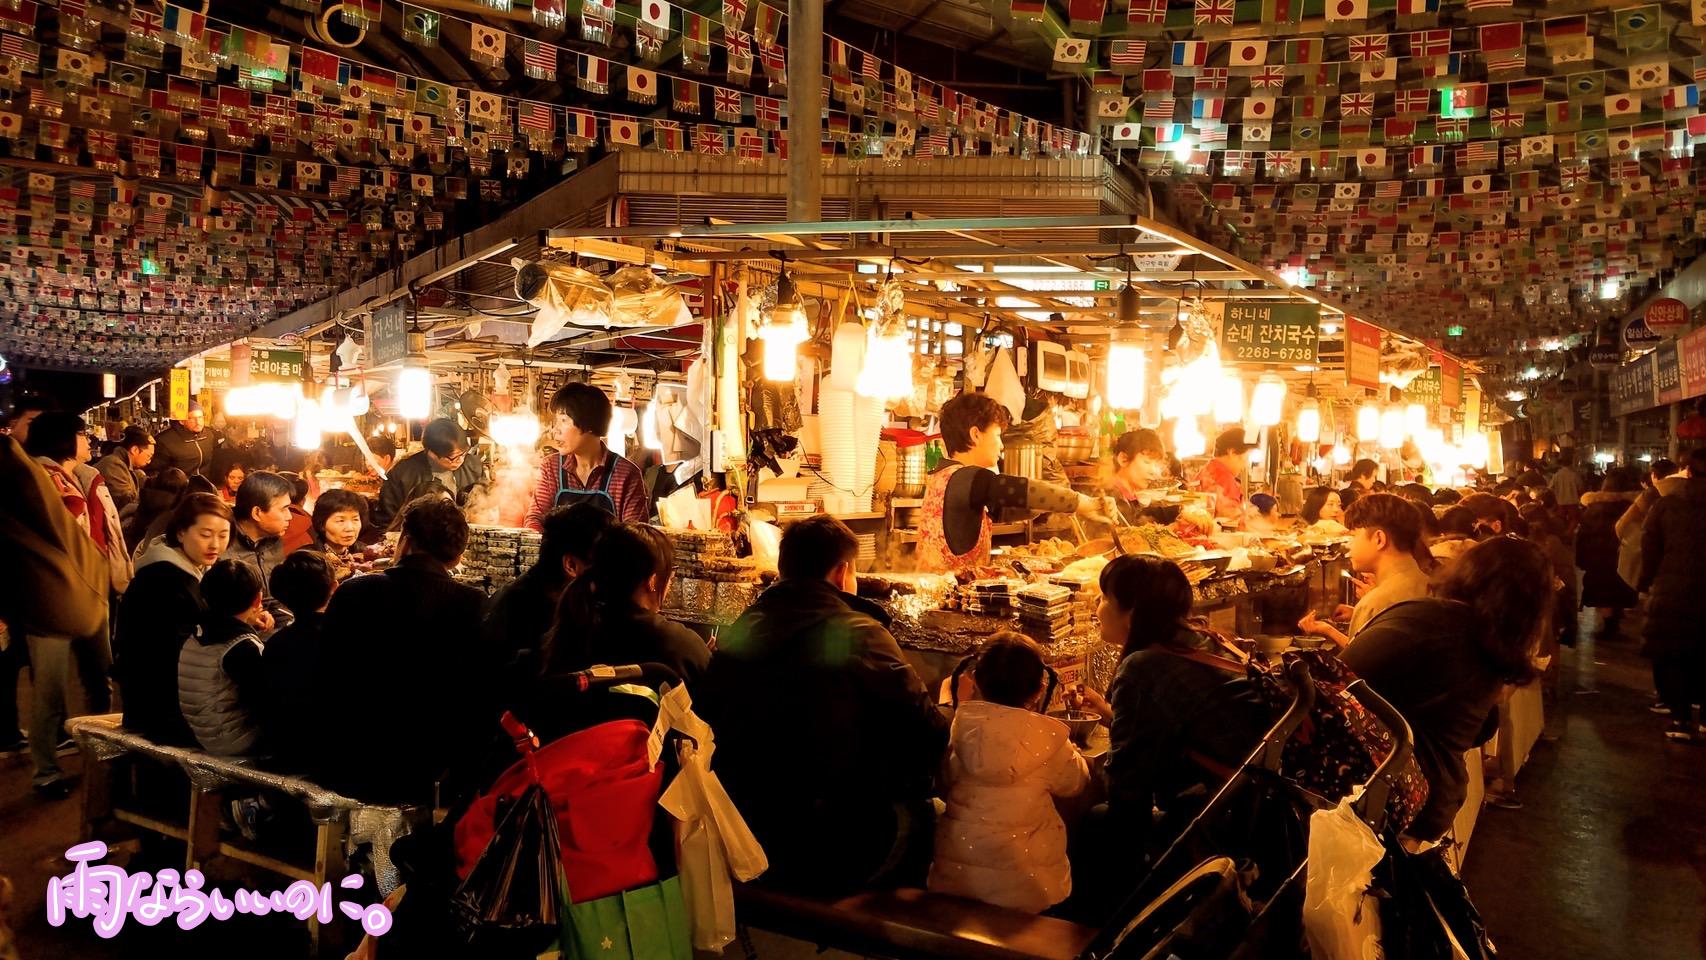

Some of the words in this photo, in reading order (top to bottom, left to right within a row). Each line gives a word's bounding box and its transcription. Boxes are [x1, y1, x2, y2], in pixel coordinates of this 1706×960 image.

[1230, 307, 1271, 321] 하니네
[1648, 304, 1685, 322] 신안상회
[1226, 324, 1254, 343] 순대
[1259, 324, 1316, 345] 잔치국수
[1237, 346, 1312, 361] 2268-6738
